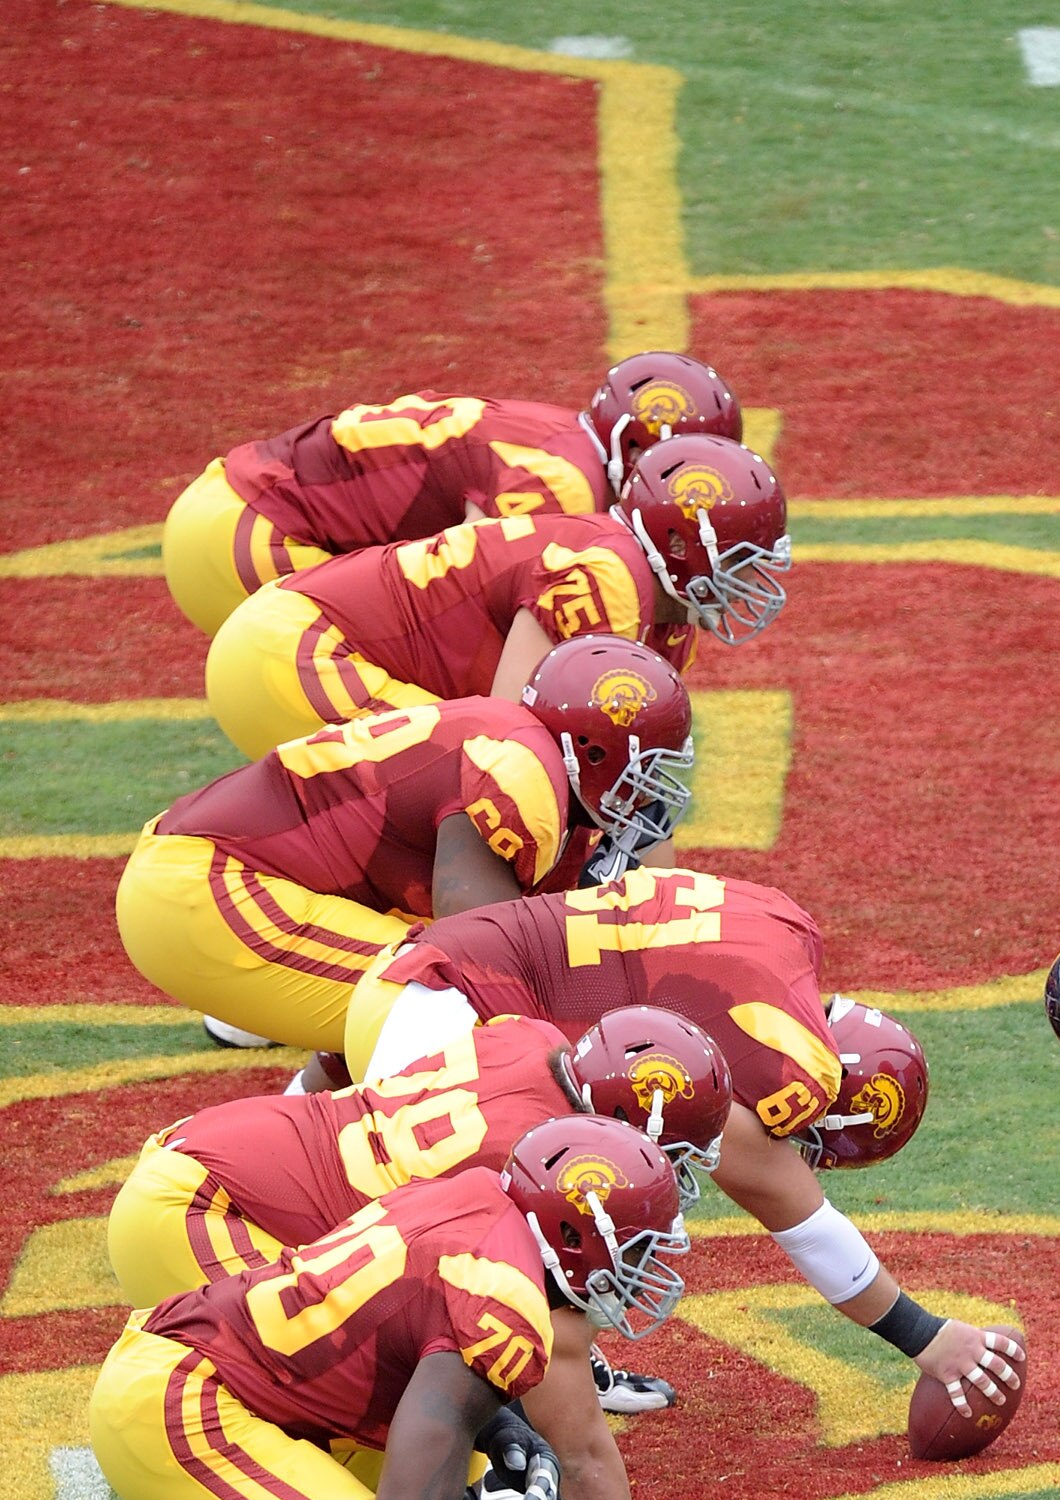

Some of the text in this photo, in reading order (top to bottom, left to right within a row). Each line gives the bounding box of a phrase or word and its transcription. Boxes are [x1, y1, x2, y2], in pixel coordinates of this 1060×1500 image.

[536, 567, 602, 640] 75
[564, 865, 727, 968] 61
[755, 1080, 820, 1137] 61
[460, 1311, 535, 1391] 70
